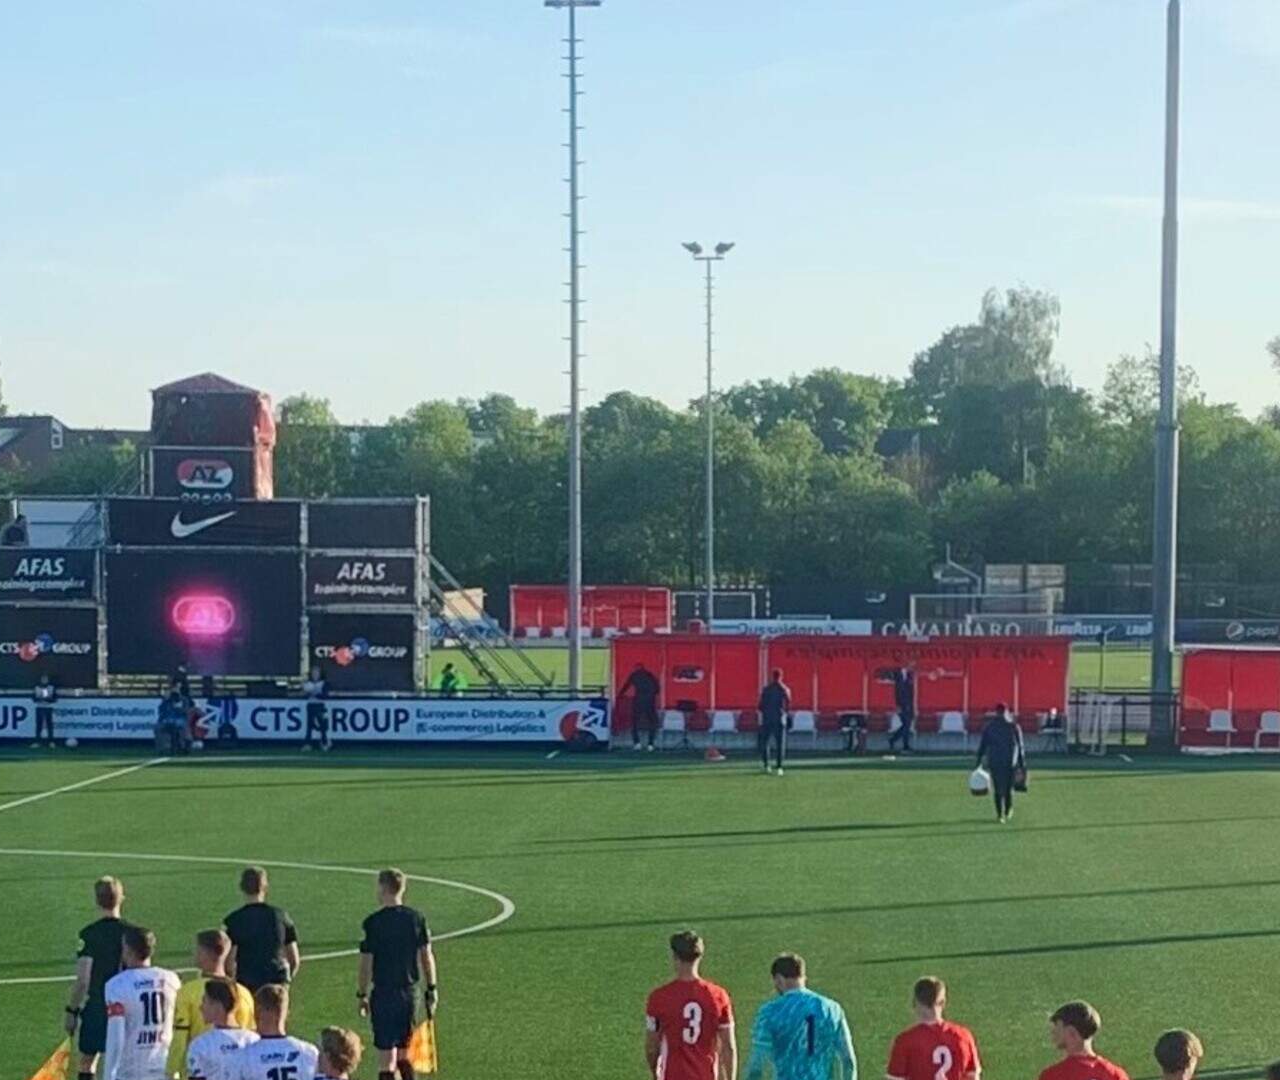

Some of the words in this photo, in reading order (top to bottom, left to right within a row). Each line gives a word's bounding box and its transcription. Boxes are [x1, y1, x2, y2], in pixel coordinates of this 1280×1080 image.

[189, 465, 223, 483] AZ
[15, 558, 65, 576] AFAS
[337, 562, 386, 580] AFAS
[0, 642, 20, 654] CTS
[52, 642, 92, 654] GROUP
[315, 646, 336, 658] CTS
[368, 646, 408, 658] GROUP
[91, 706, 156, 718] Distribution
[250, 706, 302, 732] CTS
[320, 707, 410, 732] ROUP
[416, 707, 469, 720] European
[472, 707, 536, 719] Distribution
[496, 722, 547, 735] Logistics
[140, 991, 165, 1026] 10
[682, 1001, 703, 1045] 3
[805, 1013, 816, 1056] 1
